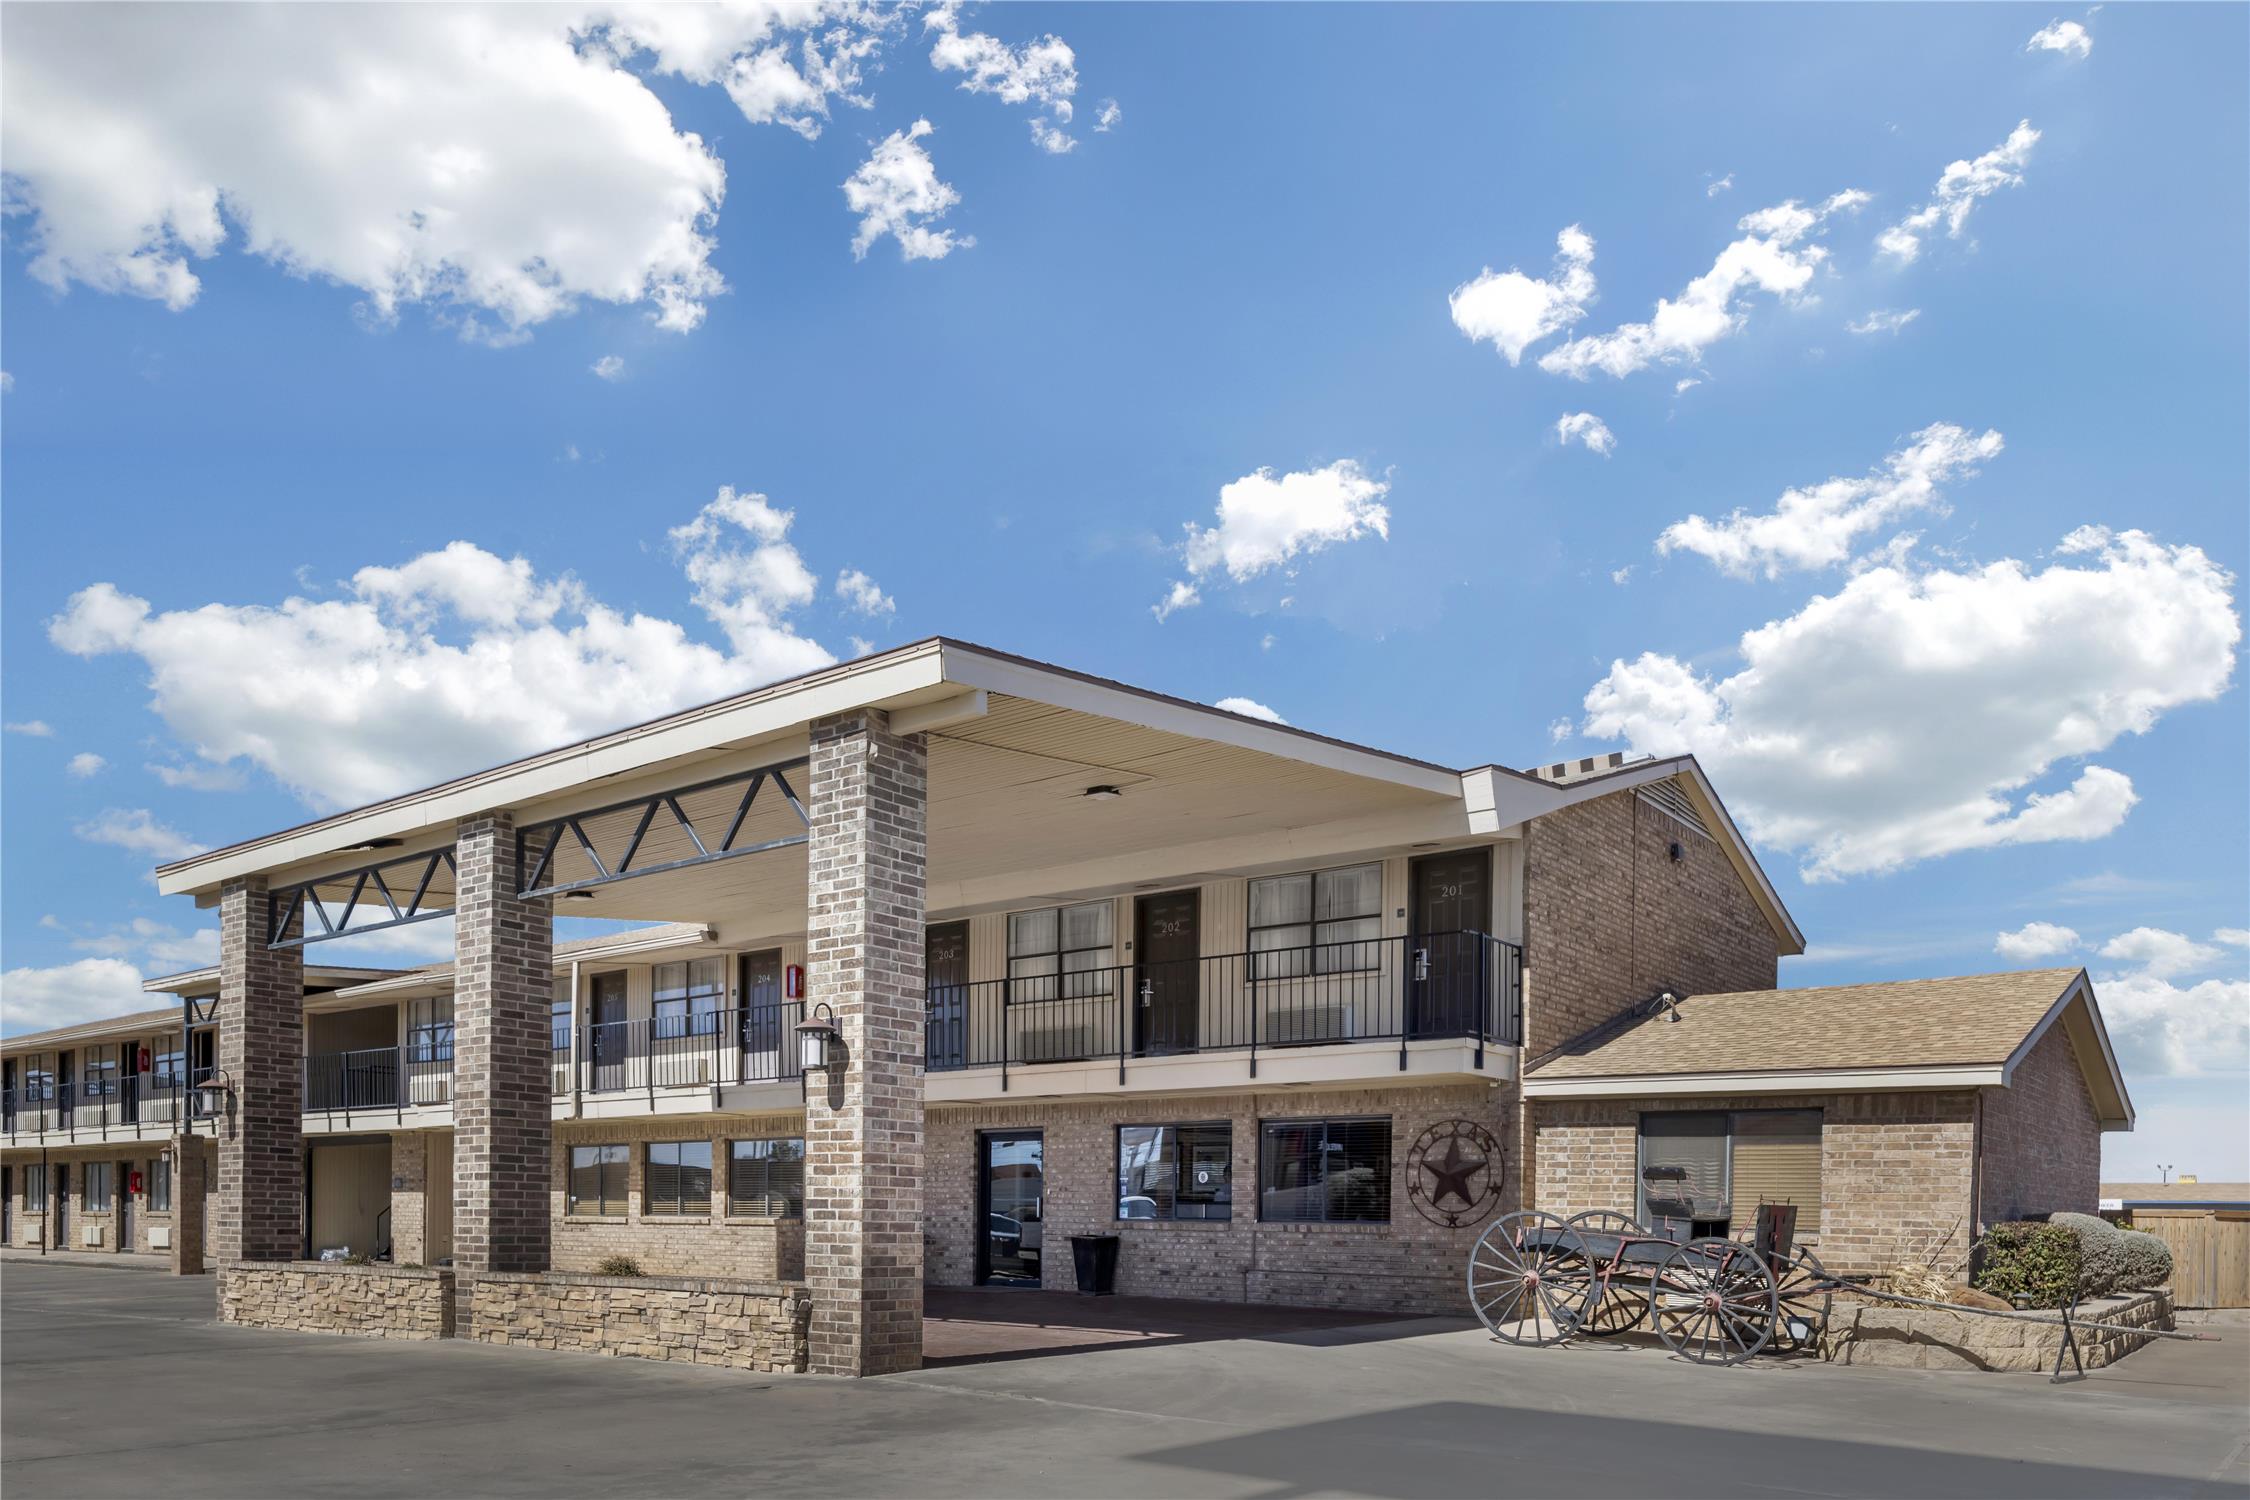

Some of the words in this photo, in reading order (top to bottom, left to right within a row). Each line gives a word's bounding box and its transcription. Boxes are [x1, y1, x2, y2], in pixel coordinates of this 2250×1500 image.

[1442, 885, 1462, 897] 201
[1162, 920, 1180, 933] 202
[938, 950, 954, 960] 203
[758, 974, 770, 984] 204
[1409, 1119, 1498, 1154] TEXAS
